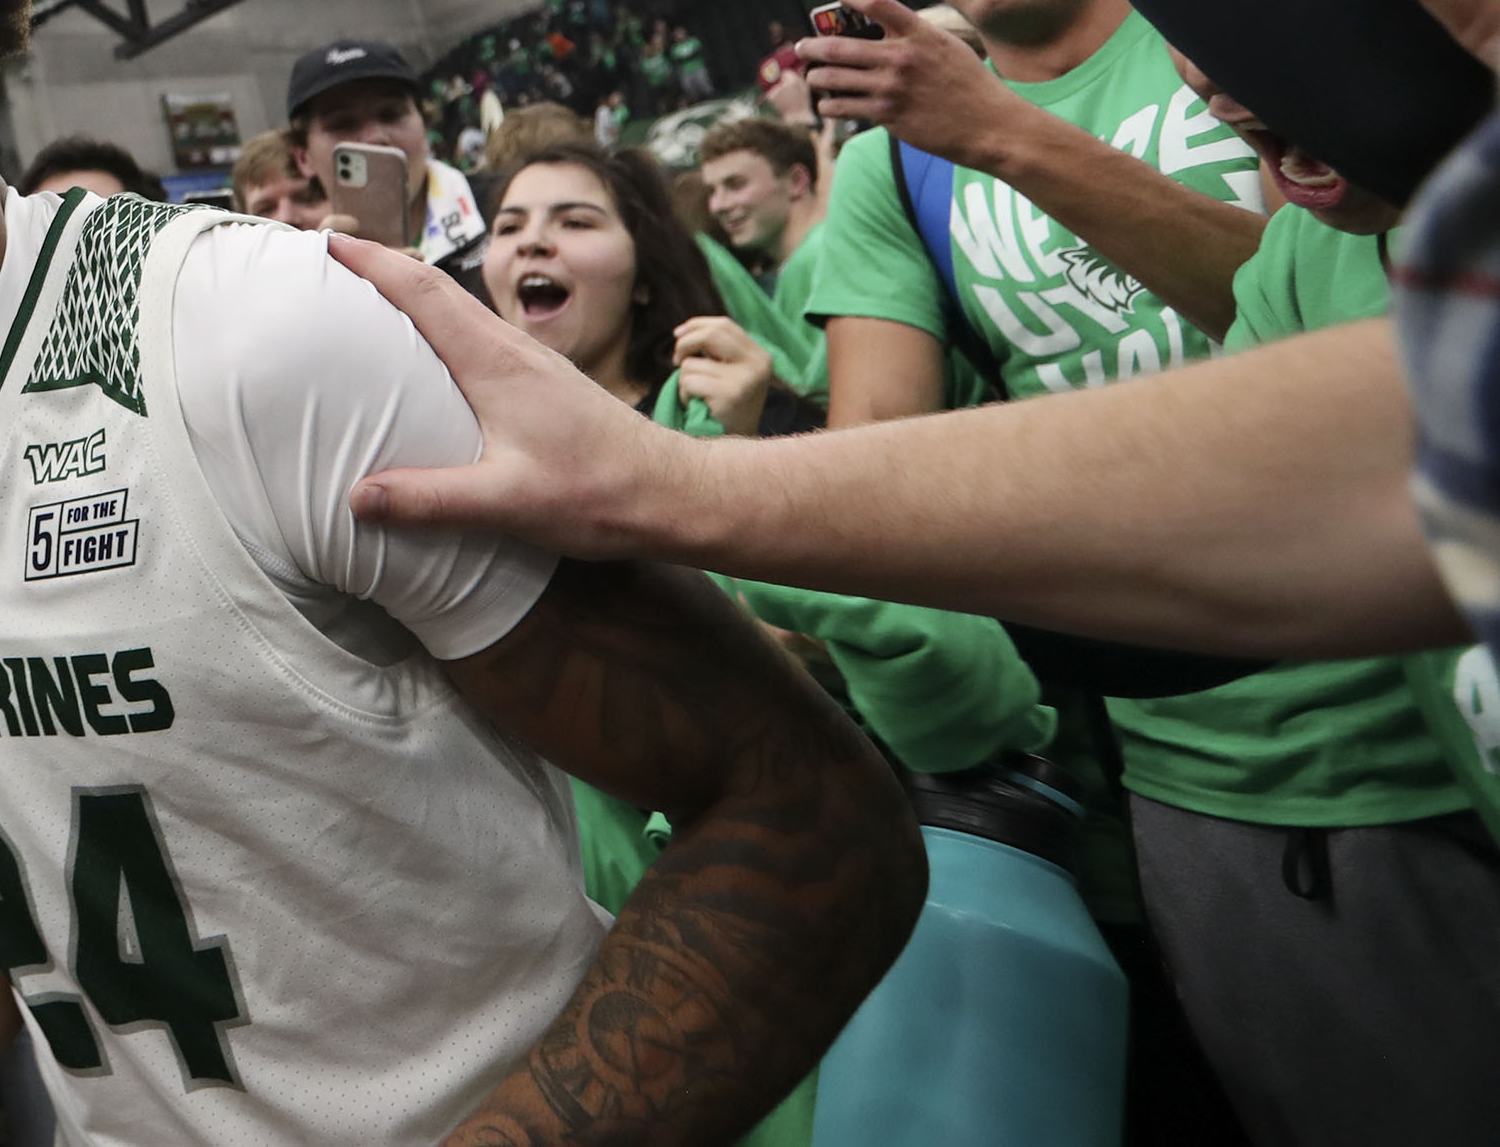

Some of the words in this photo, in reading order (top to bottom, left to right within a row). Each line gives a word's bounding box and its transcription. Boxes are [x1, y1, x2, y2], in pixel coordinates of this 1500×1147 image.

[23, 428, 106, 485] WAC
[67, 506, 89, 524] FOR
[93, 500, 117, 519] THE
[32, 512, 54, 571] 5
[64, 530, 128, 566] FIGHT
